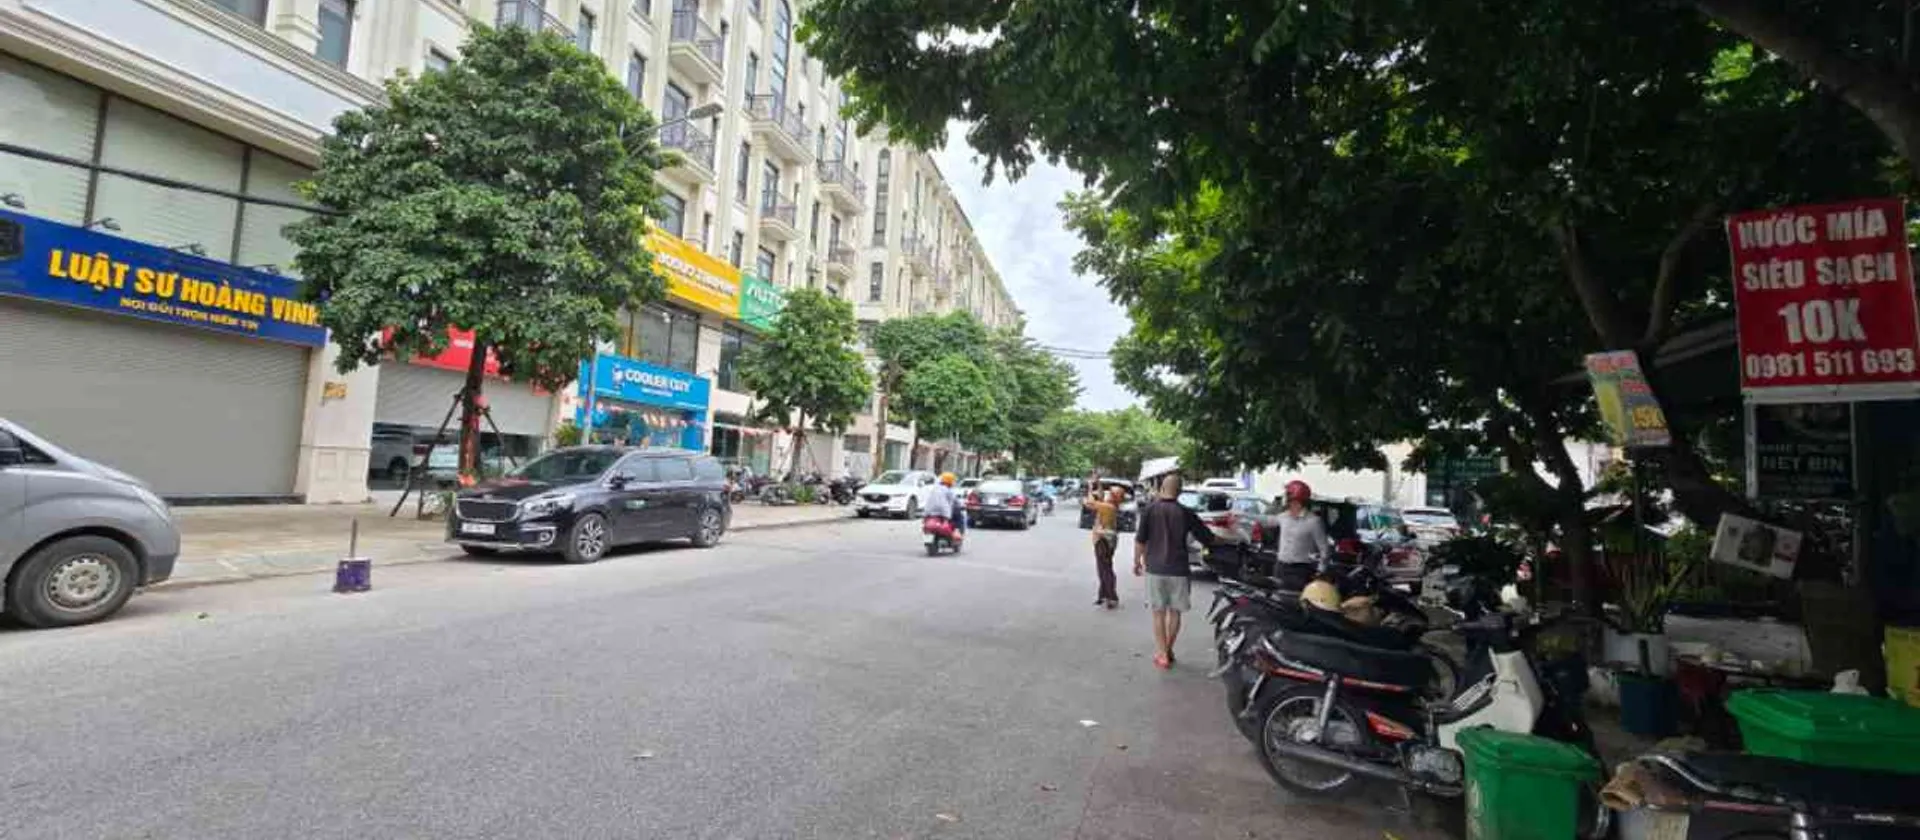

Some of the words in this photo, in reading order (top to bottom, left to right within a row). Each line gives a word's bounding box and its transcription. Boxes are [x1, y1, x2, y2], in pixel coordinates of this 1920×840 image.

[1827, 206, 1887, 242] MÍA
[49, 249, 130, 292] LUẬT
[134, 267, 179, 299] SƯ
[181, 278, 267, 317] HOÀNG
[1778, 298, 1866, 344] 10K
[1746, 353, 1806, 379] 0981
[1814, 351, 1855, 376] 511
[1862, 347, 1916, 374] 693
